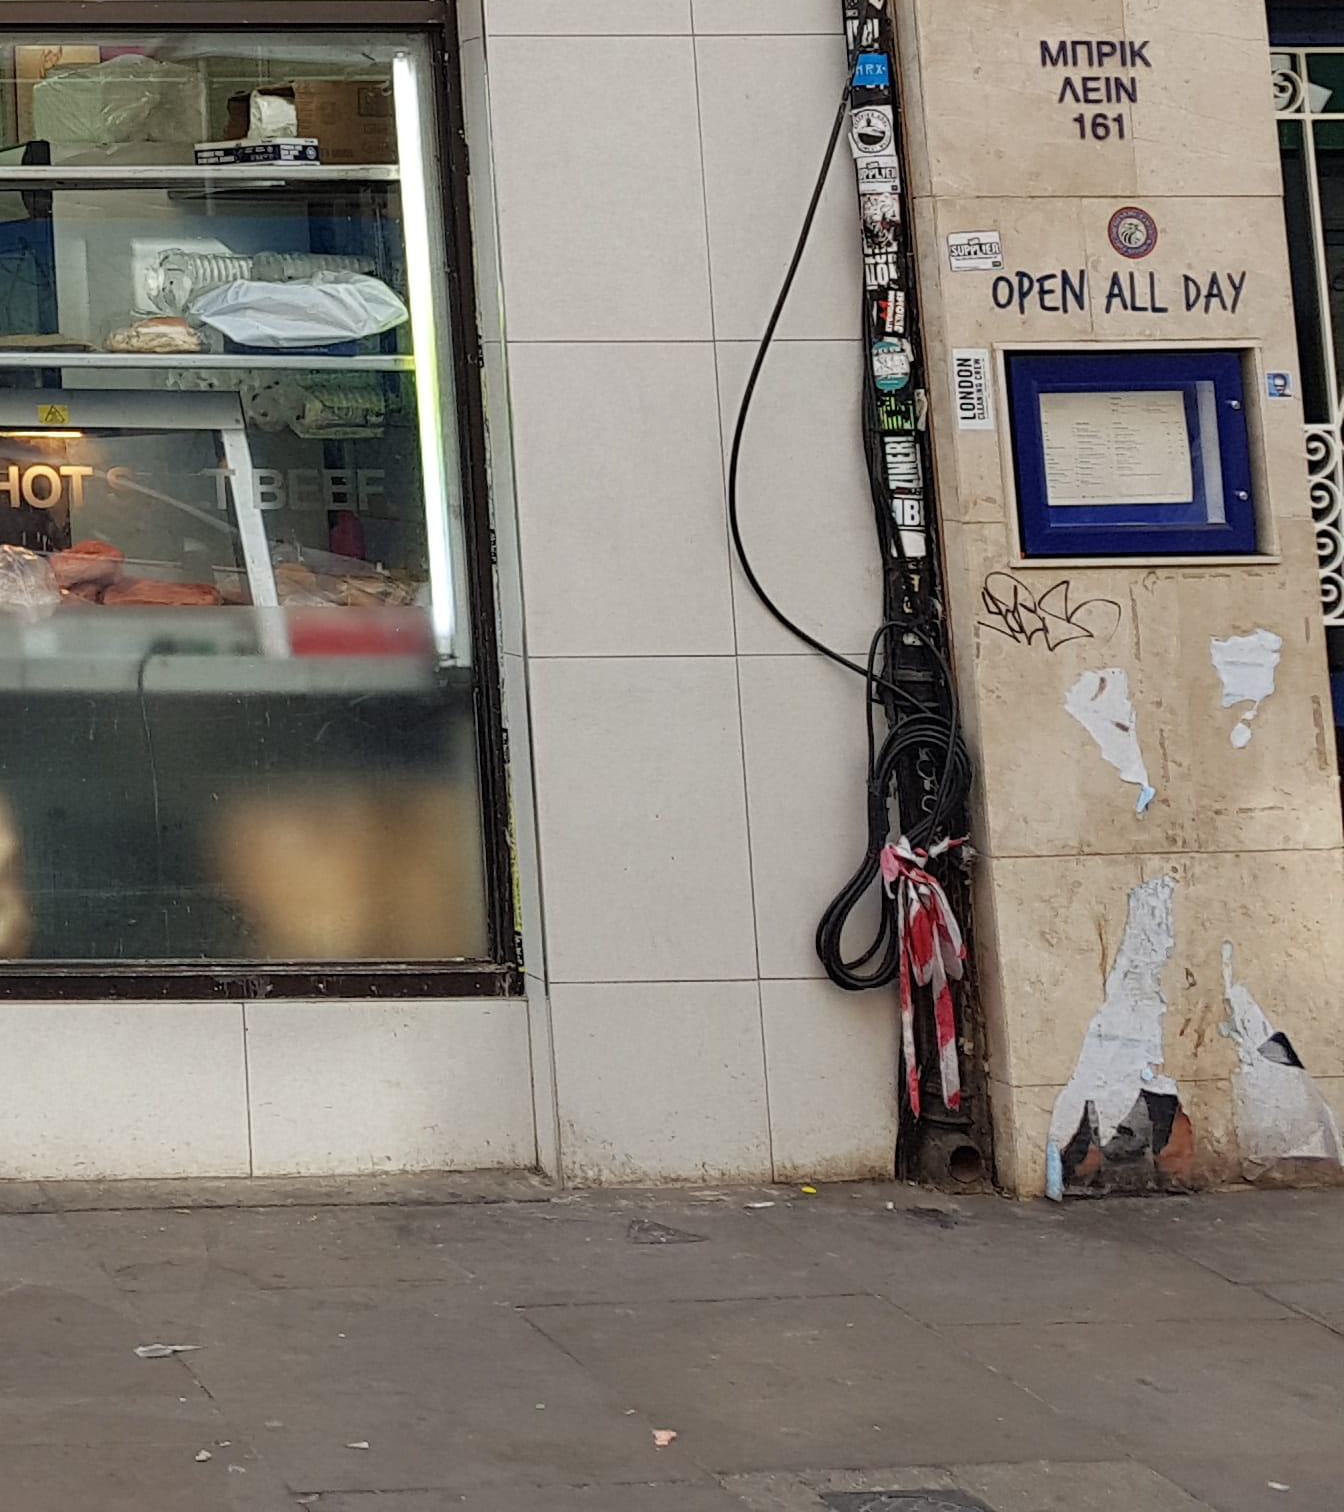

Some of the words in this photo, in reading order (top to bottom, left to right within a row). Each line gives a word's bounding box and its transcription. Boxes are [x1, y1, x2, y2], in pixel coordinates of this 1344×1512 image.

[1040, 40, 1152, 68] ΜΠΡΙΚ
[1058, 76, 1138, 104] ΛΕΙΝ
[1073, 113, 1125, 140] 161
[992, 270, 1085, 314] OPEN
[1106, 272, 1169, 314] ALL
[1183, 271, 1246, 314] DAY
[956, 358, 976, 420] LONDON
